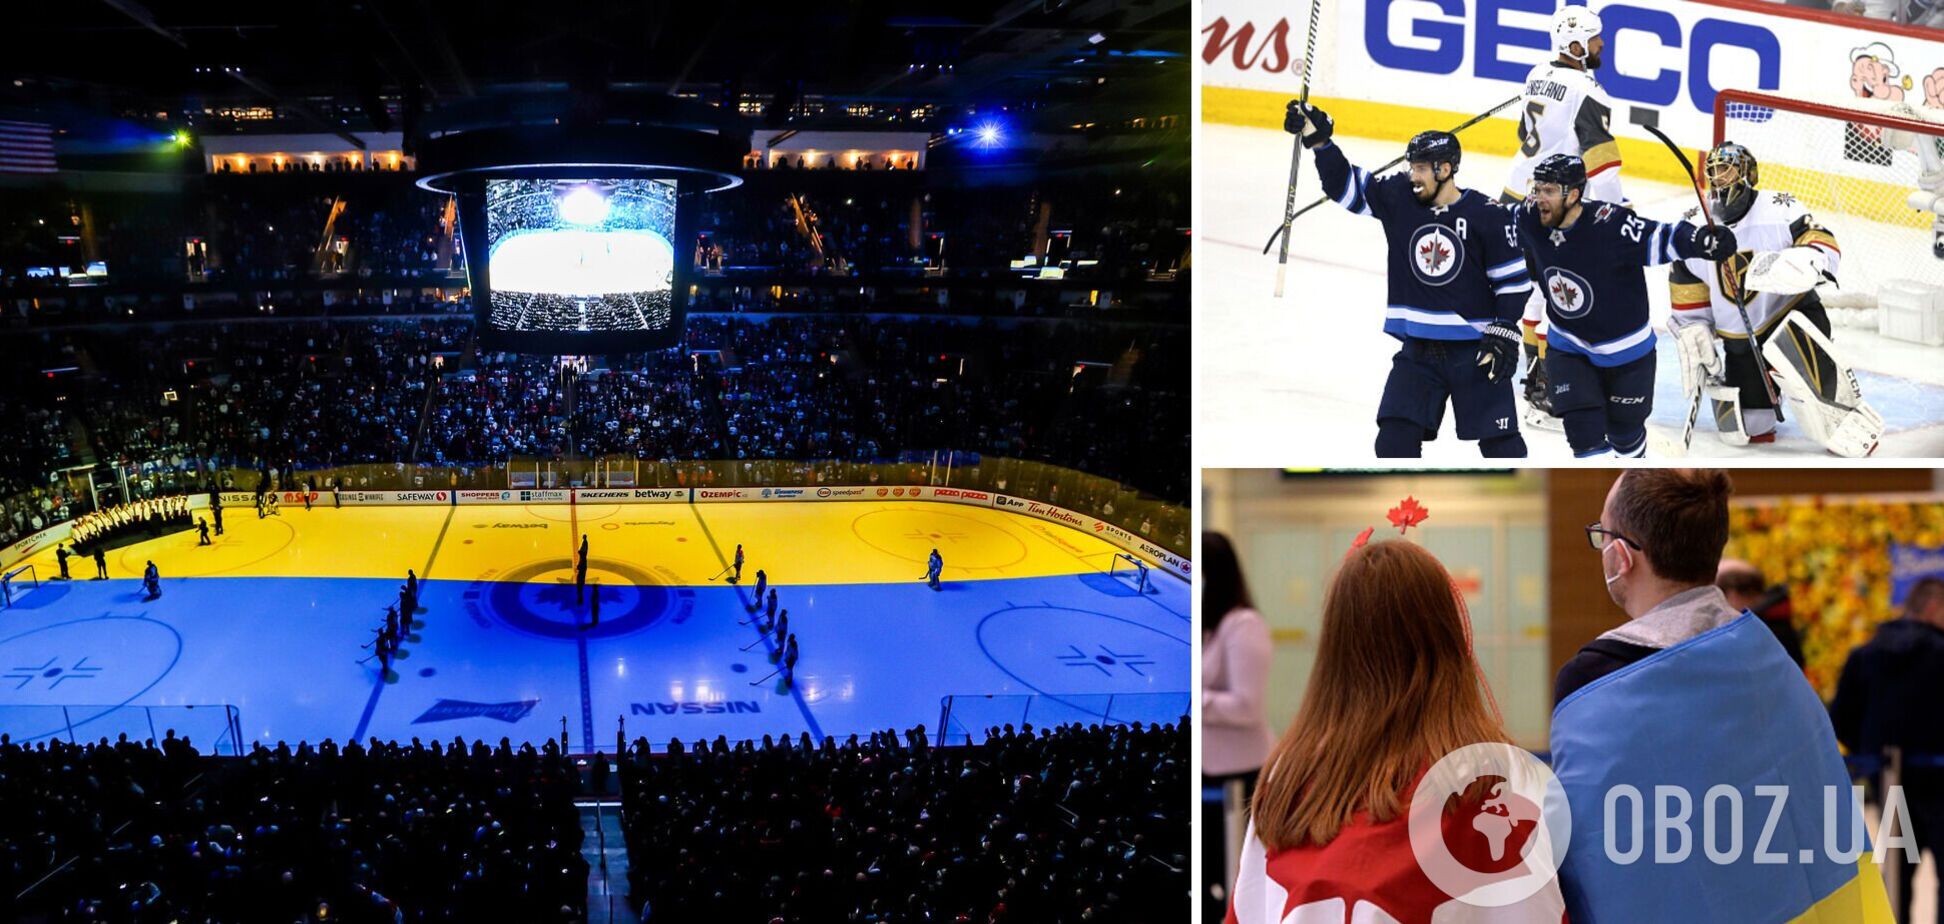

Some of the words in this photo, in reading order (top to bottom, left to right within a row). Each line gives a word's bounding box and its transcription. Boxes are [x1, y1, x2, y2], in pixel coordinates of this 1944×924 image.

[1364, 0, 1781, 122] GECO
[1455, 217, 1467, 240] A
[1621, 214, 1646, 243] 25
[1484, 324, 1522, 343] WARRIO
[1845, 368, 1862, 399] CCM
[1609, 395, 1646, 404] CCM
[397, 493, 435, 501] SAFEWAY
[634, 490, 672, 499] betway
[934, 489, 960, 497] pizza
[961, 490, 988, 499] pizza
[1028, 502, 1046, 515] Tim
[1046, 506, 1083, 526] Hortons
[1106, 526, 1132, 541] SPORTS
[1140, 543, 1180, 567] AEROPLAN
[630, 700, 762, 715] NISSAN
